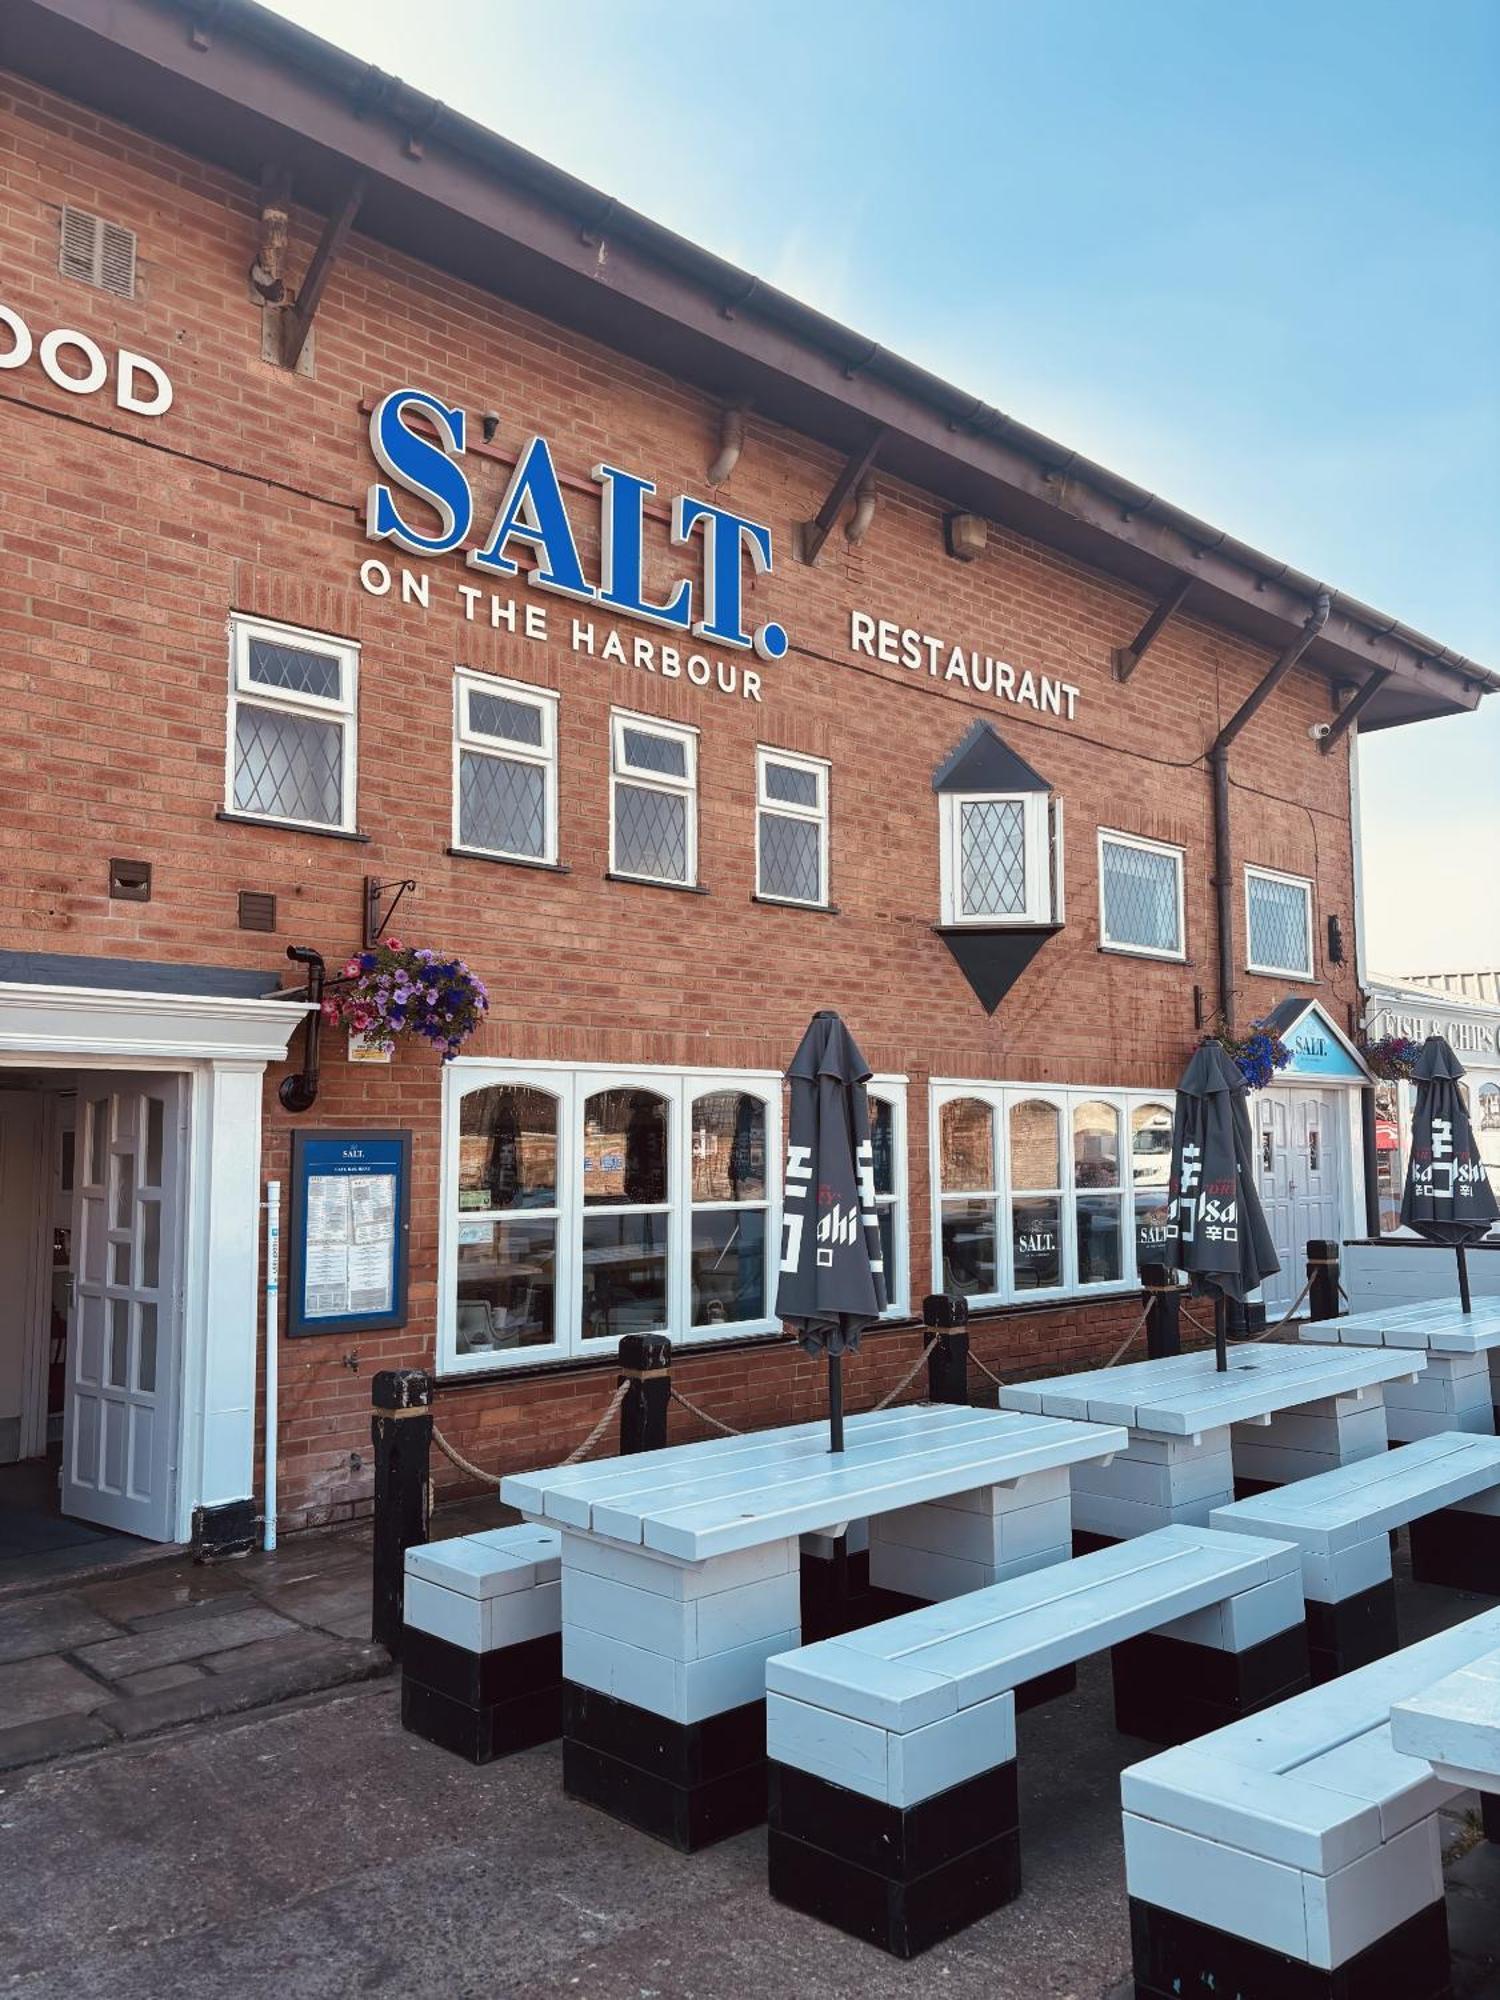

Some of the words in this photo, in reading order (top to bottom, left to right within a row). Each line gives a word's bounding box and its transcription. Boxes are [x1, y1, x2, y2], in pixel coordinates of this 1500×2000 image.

[366, 388, 789, 661] SALT.
[359, 559, 429, 608] ON
[458, 584, 548, 641] THE
[572, 619, 762, 702] HARBOUR
[851, 610, 1080, 720] RESTAURANT
[1295, 1035, 1328, 1057] SALT.
[1447, 1022, 1495, 1052] CHIPS
[1019, 1232, 1056, 1253] SALT.
